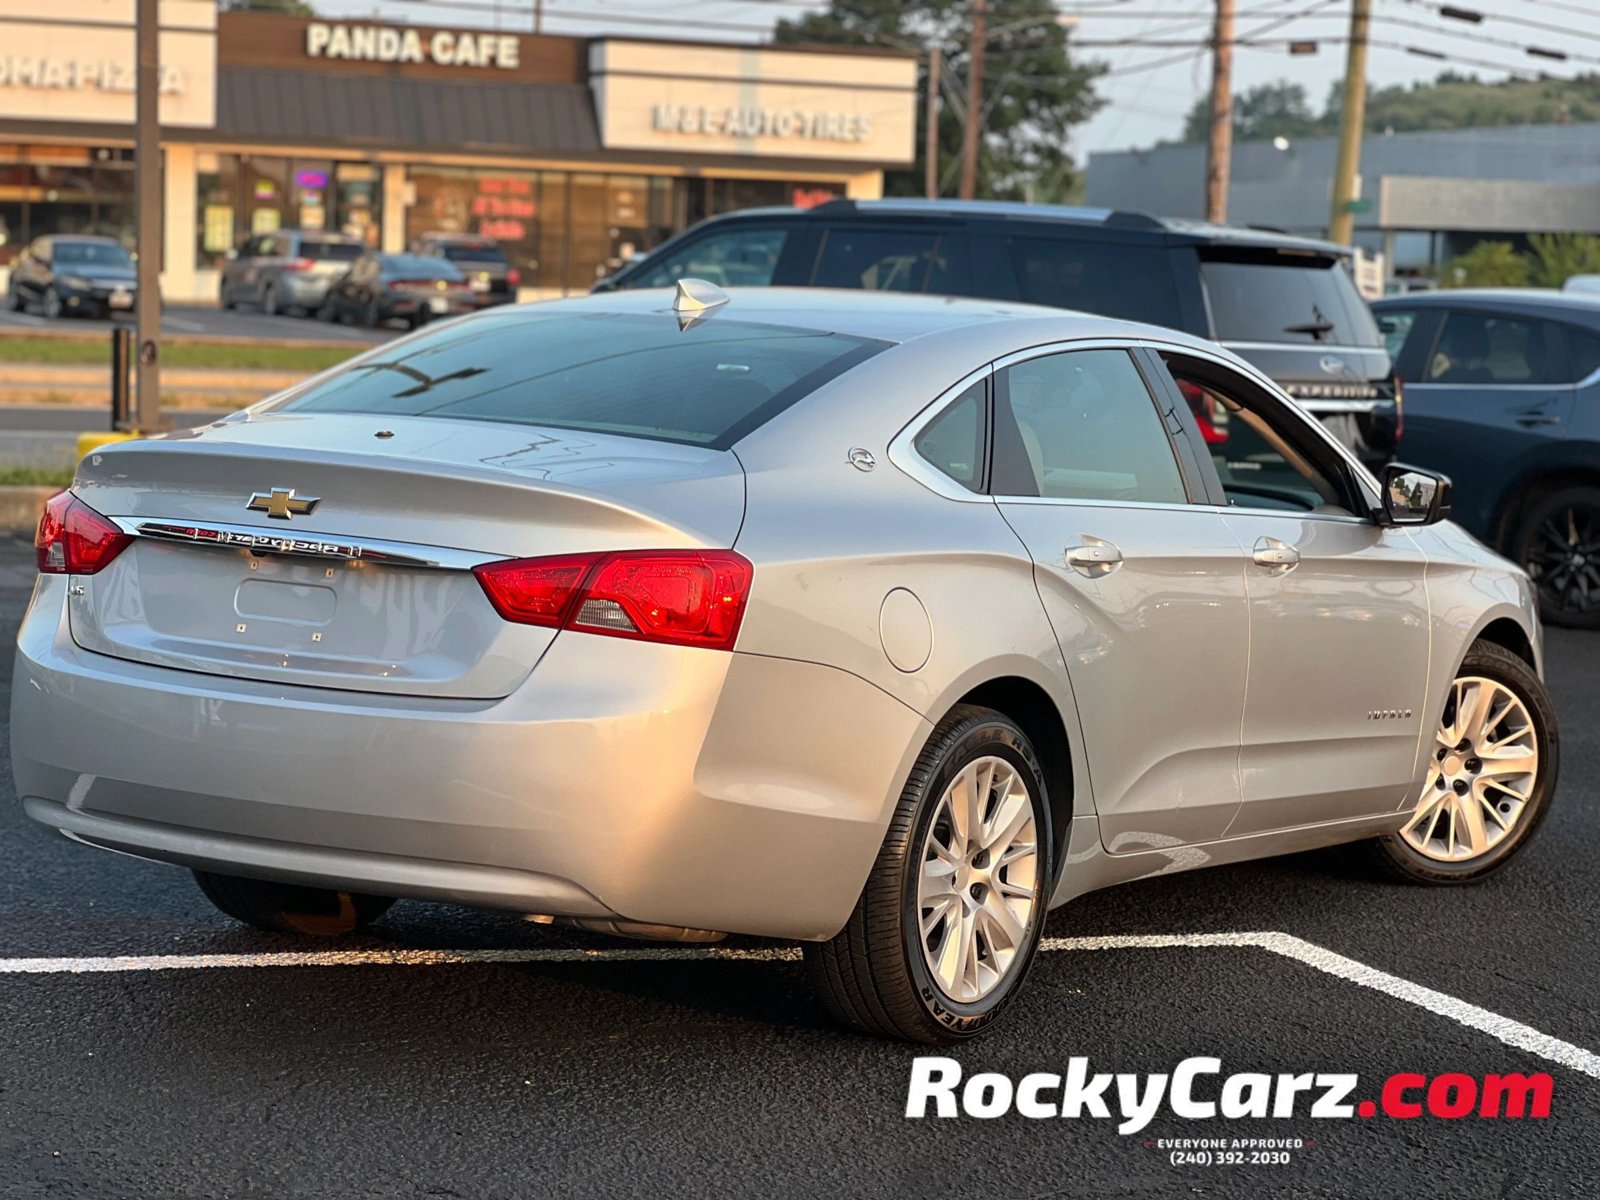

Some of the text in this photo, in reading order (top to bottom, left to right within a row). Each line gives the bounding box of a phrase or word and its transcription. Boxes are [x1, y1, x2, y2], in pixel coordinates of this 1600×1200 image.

[306, 23, 520, 69] PANDA CAFE
[73, 59, 184, 93] PIZA
[722, 106, 794, 138] AUTO
[798, 110, 873, 143] TIRES
